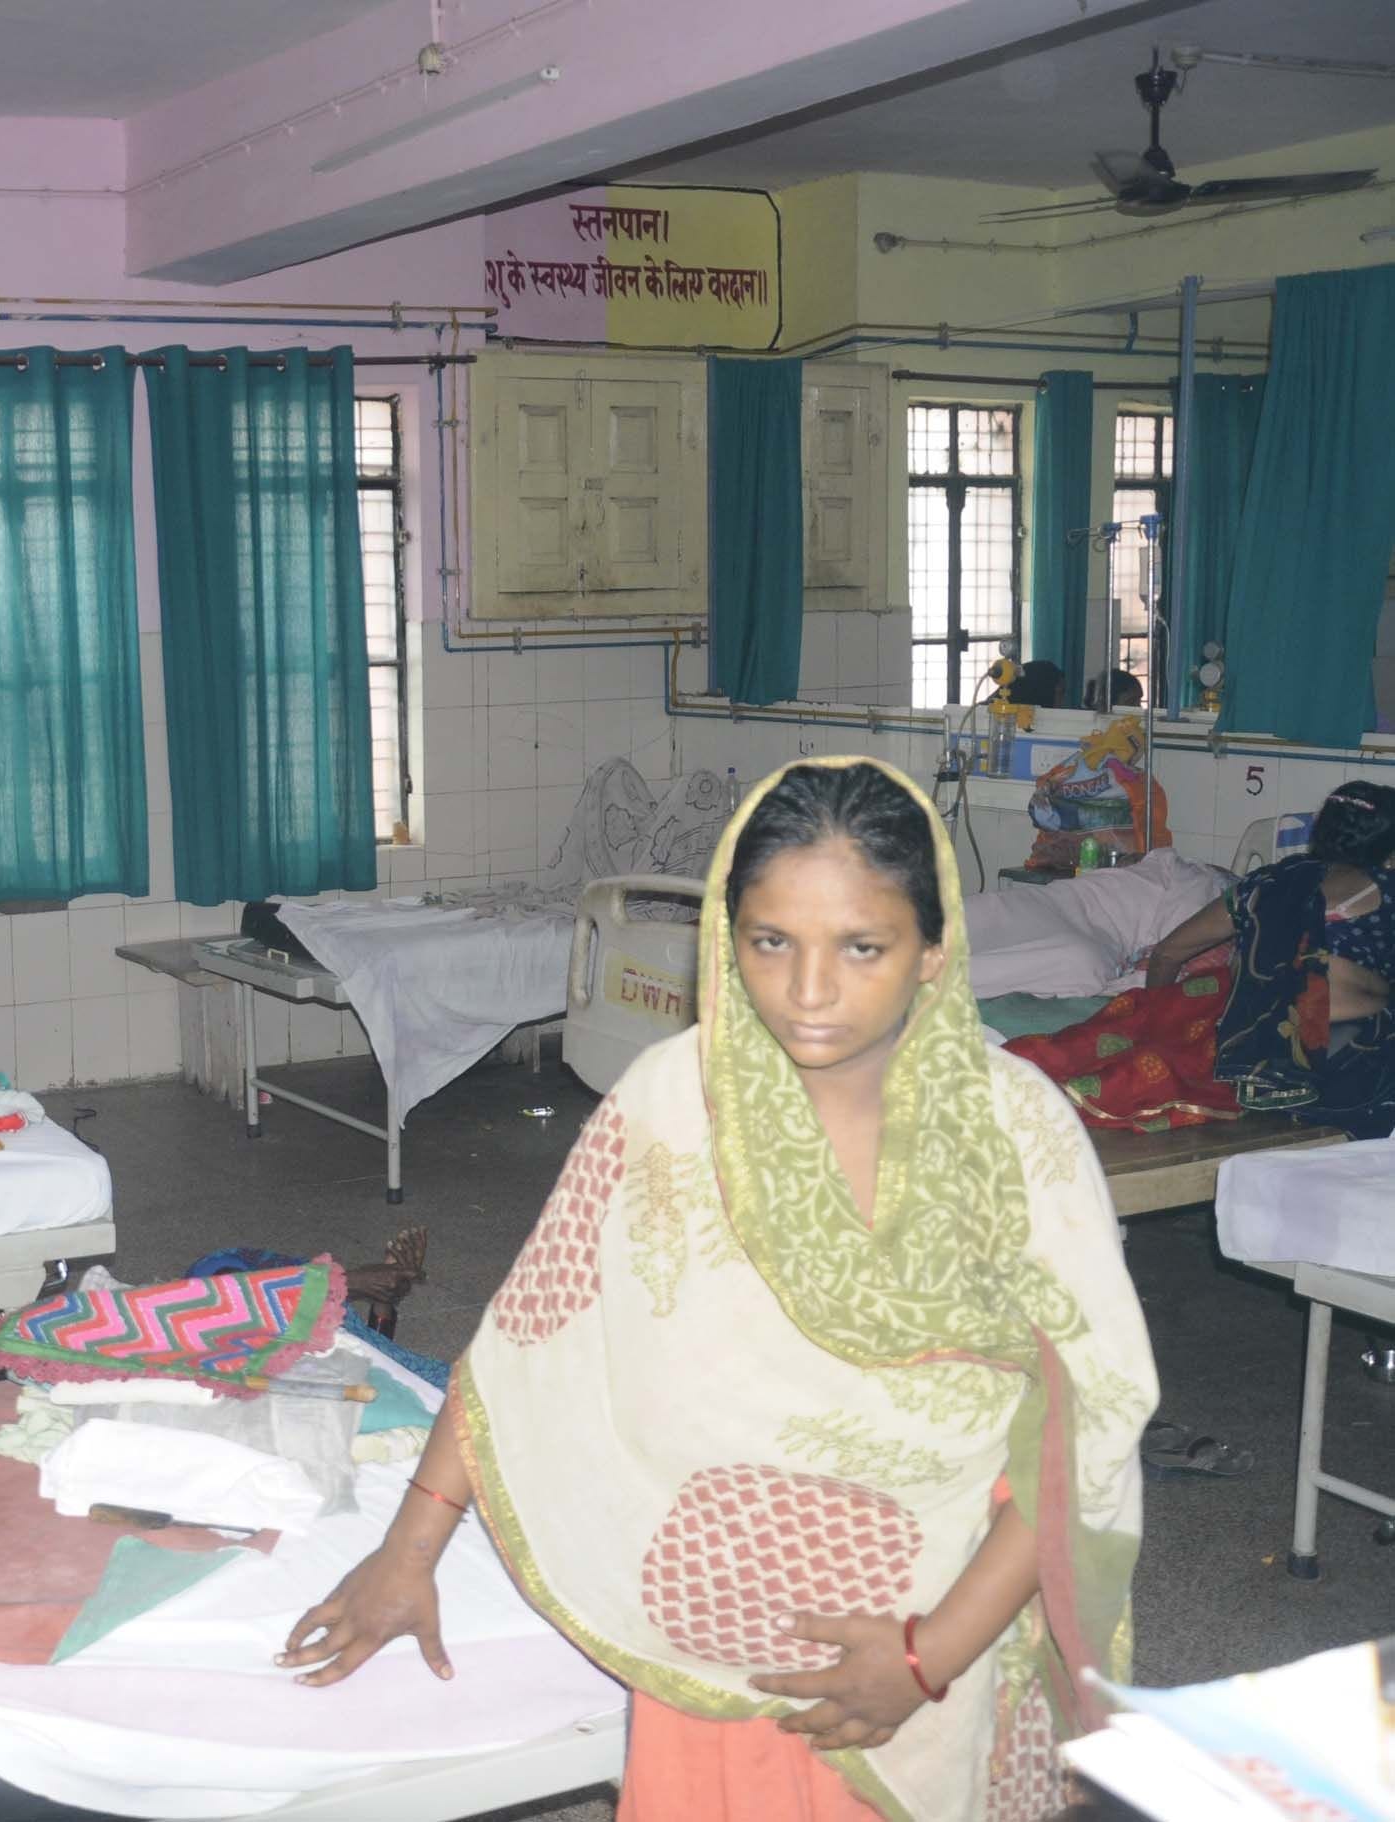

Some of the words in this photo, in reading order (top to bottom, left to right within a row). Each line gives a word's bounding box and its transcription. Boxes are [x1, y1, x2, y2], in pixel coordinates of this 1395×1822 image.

[507, 249, 526, 296] के
[591, 254, 642, 300] जीवन
[643, 254, 665, 300] के
[1246, 765, 1265, 796] 5
